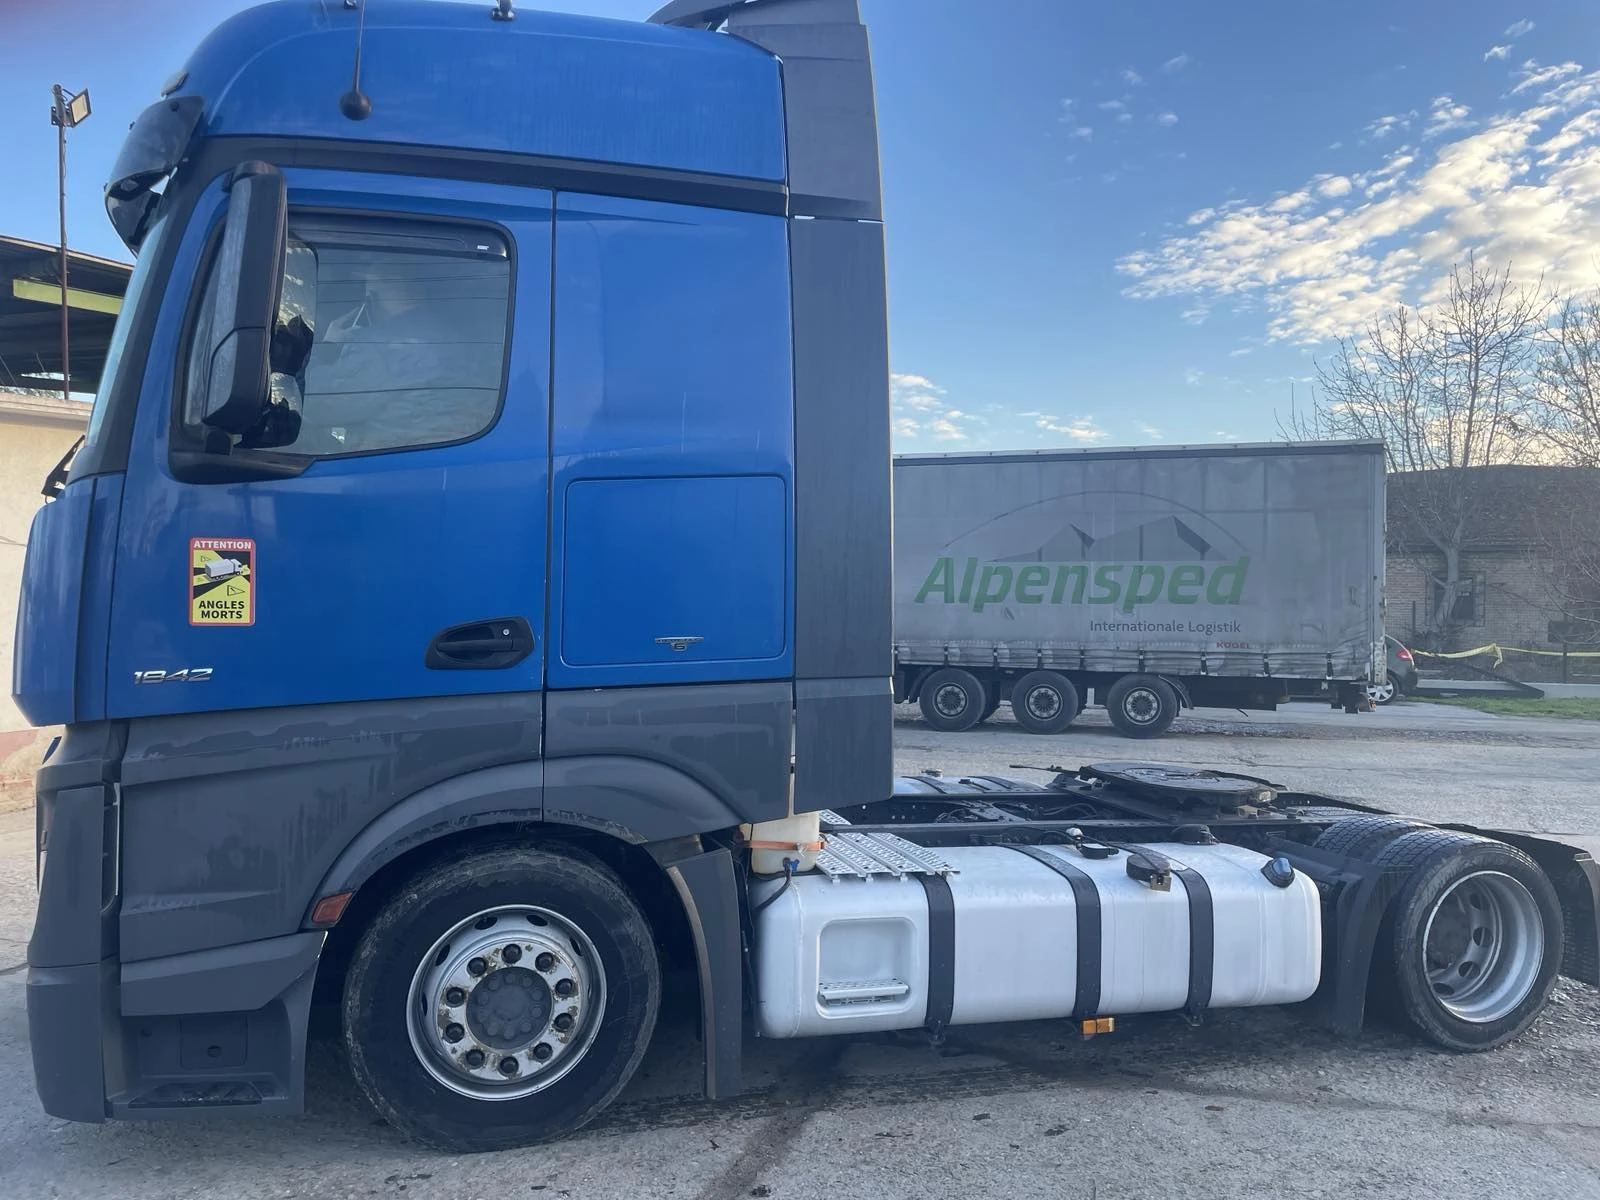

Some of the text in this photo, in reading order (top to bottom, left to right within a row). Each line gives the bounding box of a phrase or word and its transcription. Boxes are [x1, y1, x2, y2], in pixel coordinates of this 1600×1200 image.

[193, 540, 251, 549] ATTENTION
[913, 556, 1249, 614] Alpensped
[198, 600, 245, 609] ANGLES
[201, 610, 243, 619] MORTS
[1089, 619, 1241, 636] Internationale Logistik
